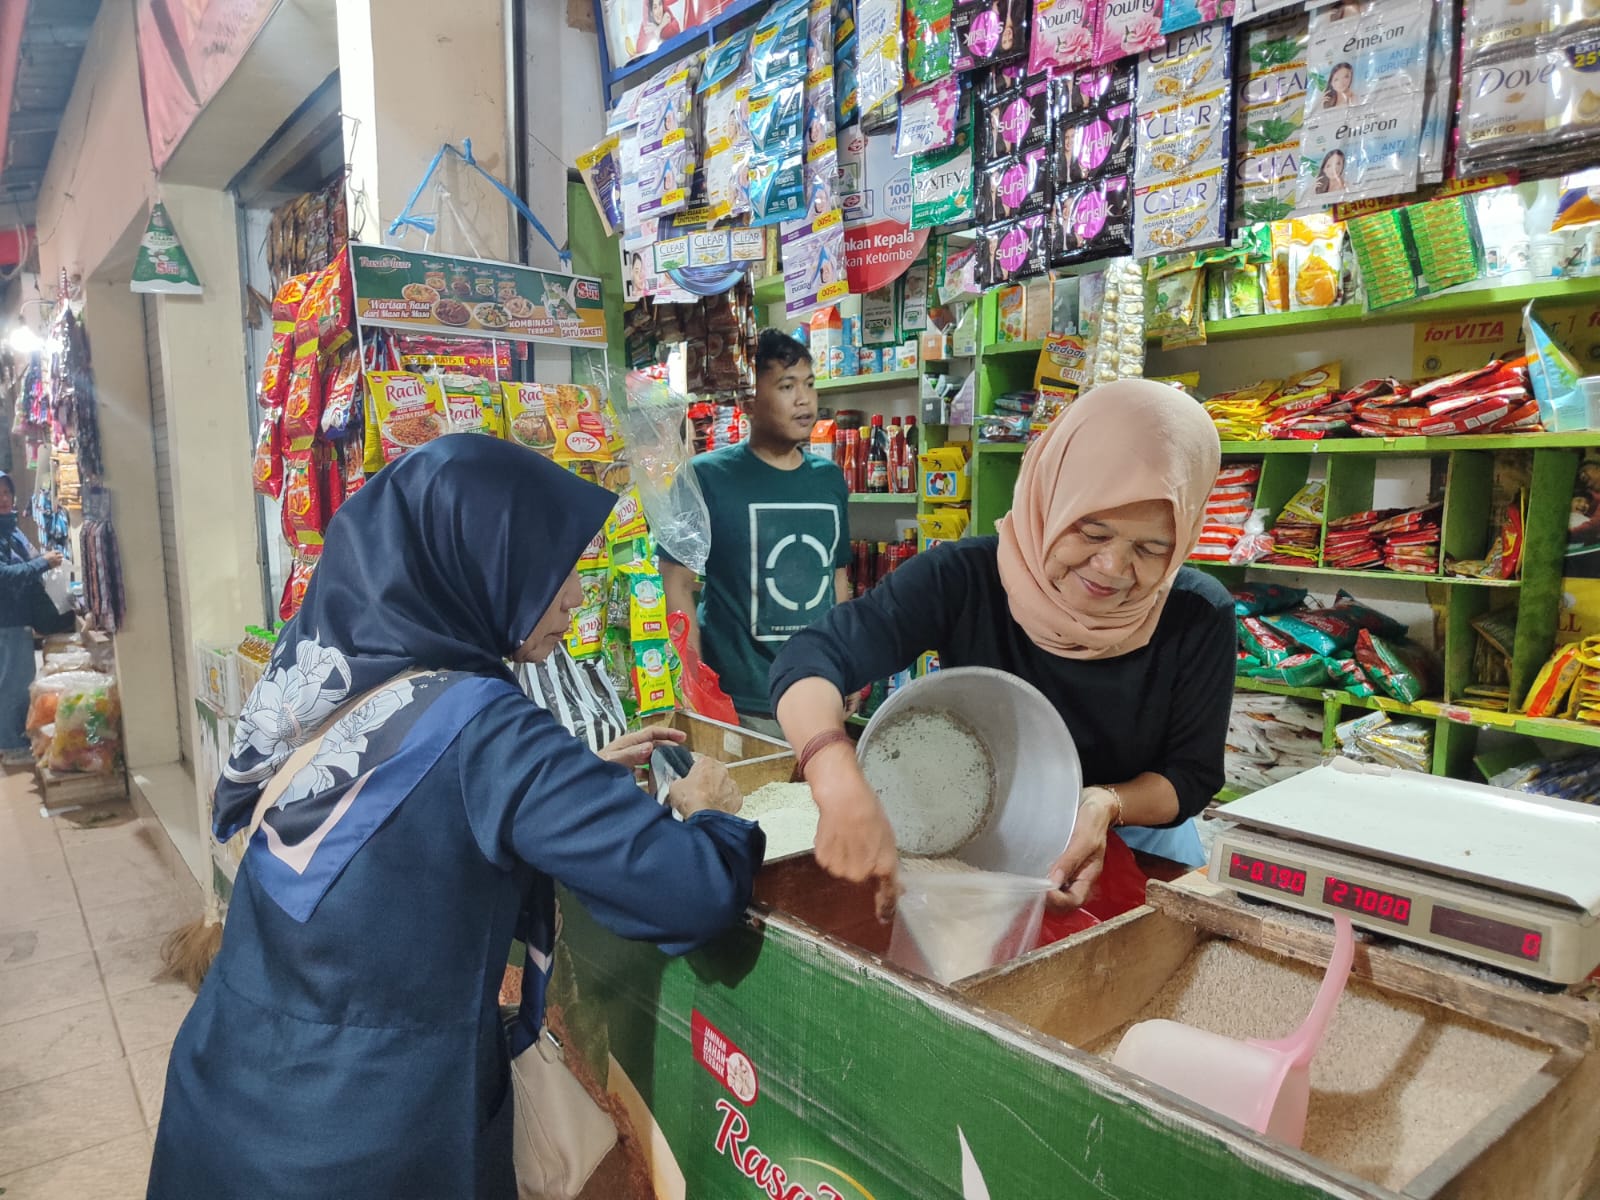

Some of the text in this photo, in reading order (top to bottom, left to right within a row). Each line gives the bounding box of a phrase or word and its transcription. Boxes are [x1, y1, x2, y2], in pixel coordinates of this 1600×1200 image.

[1040, 7, 1083, 32] Downy
[1147, 25, 1213, 64] CLEAR
[1343, 25, 1404, 53] emeron
[1364, 59, 1411, 80] DNDRUFF
[1574, 51, 1600, 69] 25
[1240, 71, 1308, 104] CLEA
[1476, 63, 1557, 98] Dove
[997, 106, 1037, 133] sunsilk
[1335, 118, 1398, 140] emeron
[1075, 130, 1118, 157] unsilk
[1471, 125, 1517, 140] SAMPO
[888, 183, 909, 196] 100
[915, 170, 968, 194] PNTEN
[996, 171, 1033, 197] sunsil
[1143, 182, 1208, 214] CLEAR
[1342, 195, 1393, 217] SACHET
[694, 234, 724, 247] CLEAR
[732, 230, 760, 243] CLEAR
[874, 230, 915, 247] Kepala
[659, 242, 685, 254] CLEAR
[866, 249, 913, 265] Ketombe
[996, 238, 1033, 260] sunsilk
[822, 285, 837, 297] 2500
[368, 299, 407, 310] Warisan
[509, 319, 553, 328] KOMBINASI
[562, 327, 602, 337] SATU PAKET!
[1424, 320, 1504, 342] forVITA
[1062, 367, 1076, 380] BELI
[385, 382, 427, 402] Racik
[447, 405, 483, 423] Racik
[615, 499, 639, 524] Racik
[1332, 884, 1410, 921] 27000
[1522, 933, 1542, 956] 0
[703, 1036, 726, 1063] BAHAN
[704, 1025, 727, 1053] JAMINAN
[703, 1050, 725, 1079] TERBAIK
